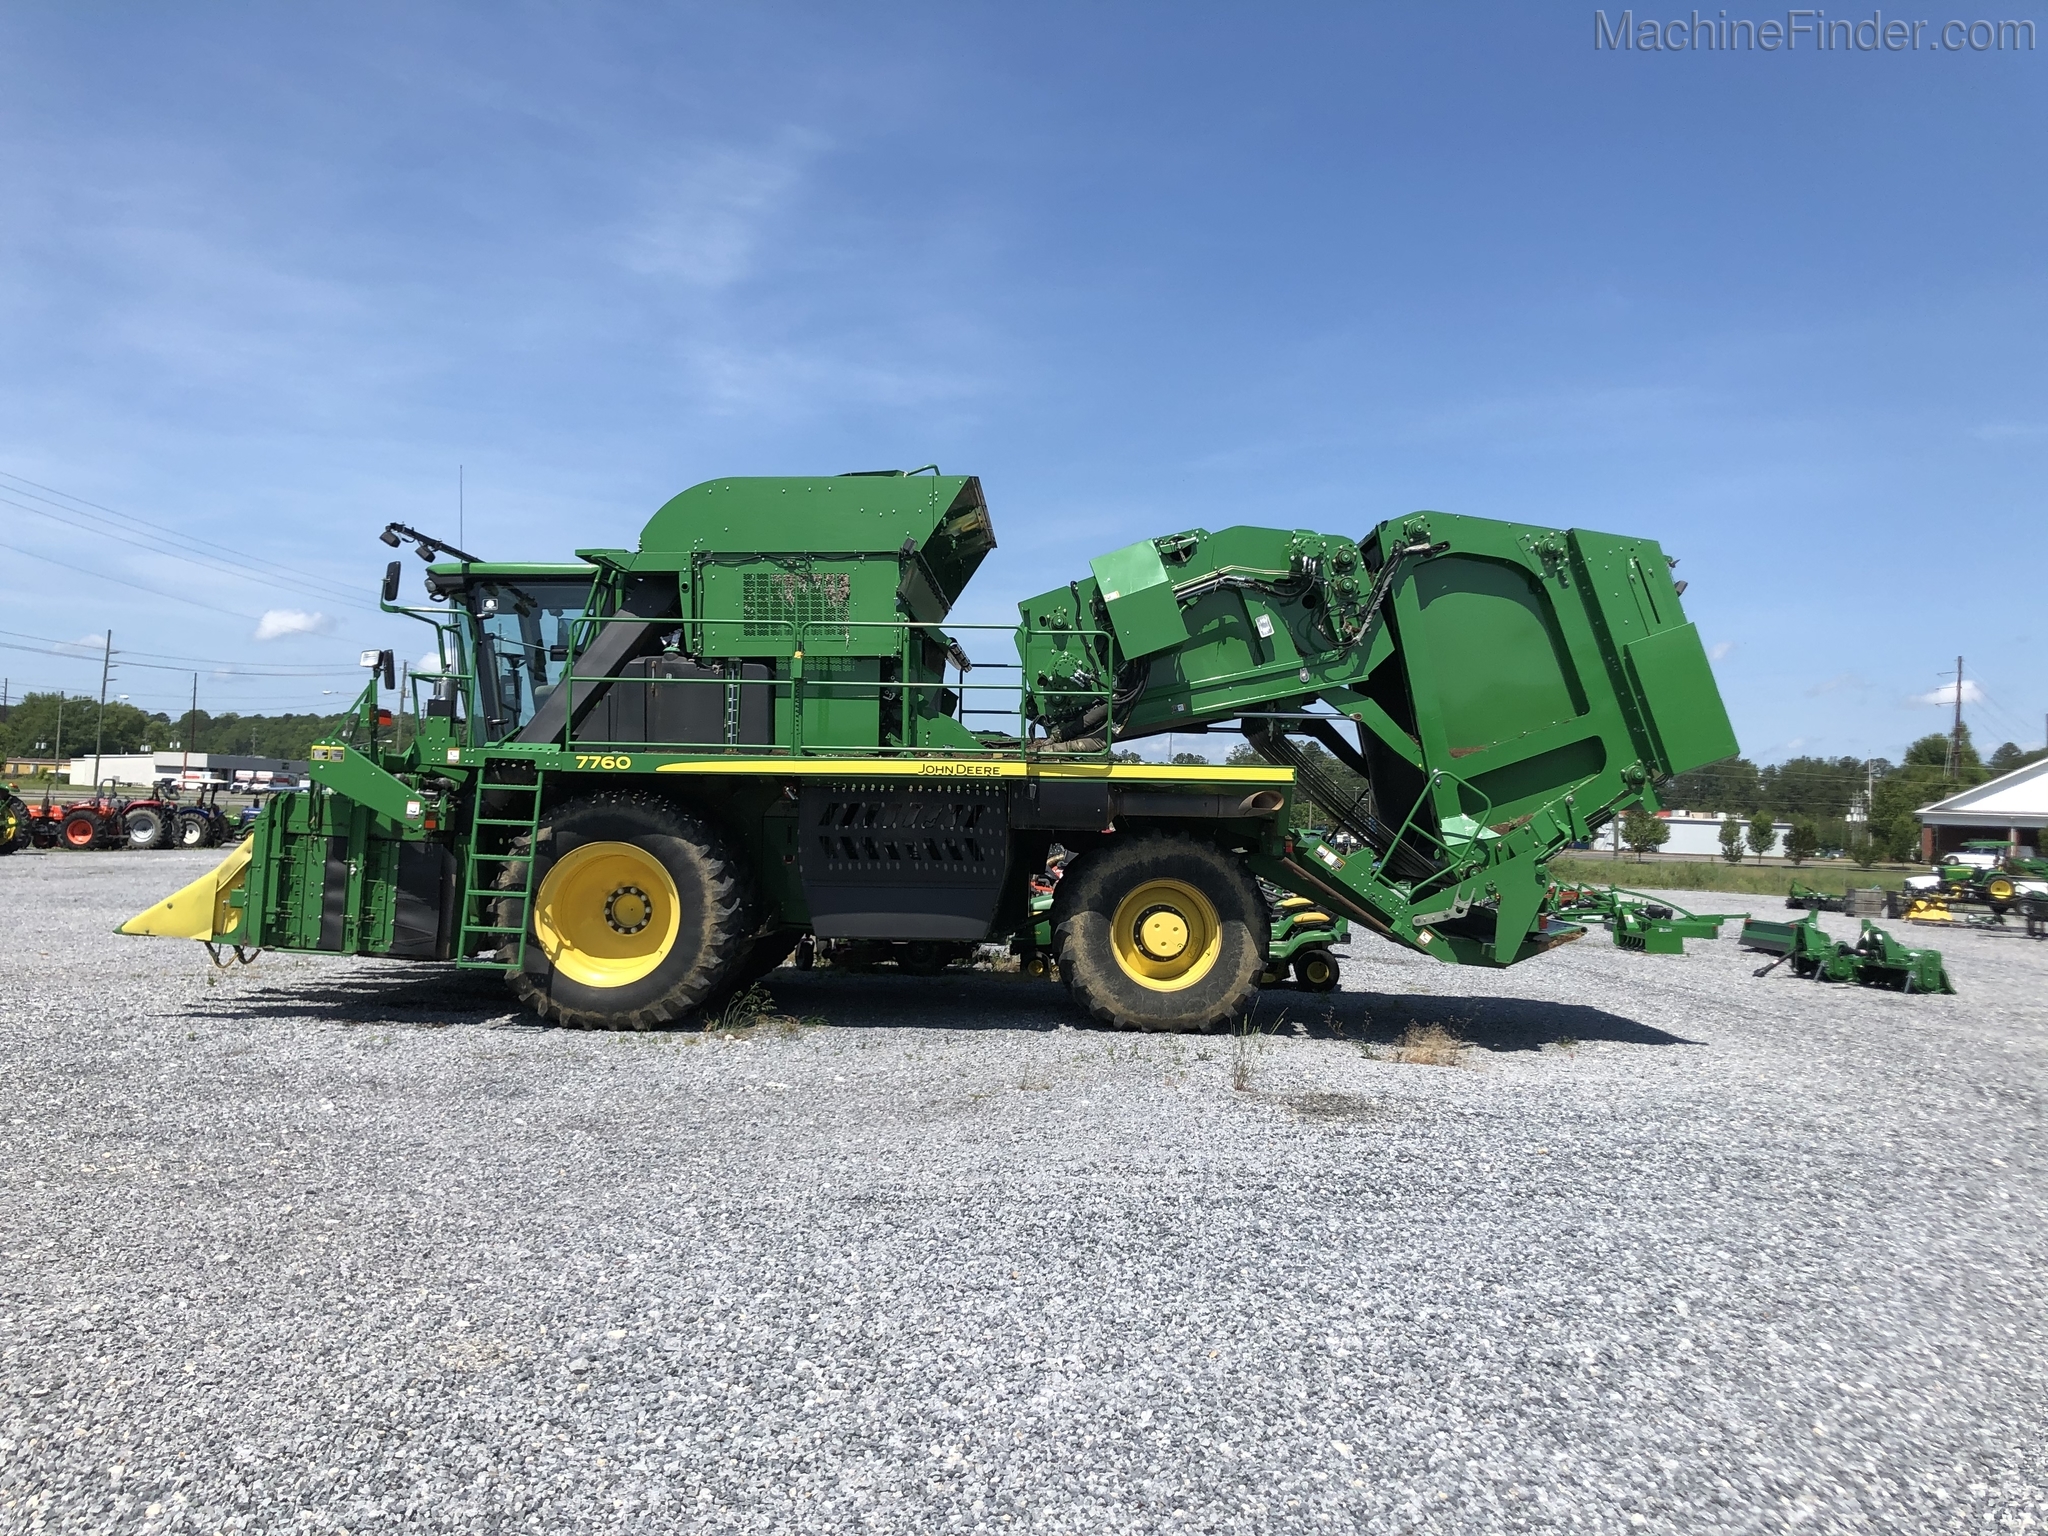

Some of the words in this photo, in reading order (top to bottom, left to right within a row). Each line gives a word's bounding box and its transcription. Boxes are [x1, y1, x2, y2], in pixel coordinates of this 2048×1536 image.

[575, 755, 632, 770] 7760
[918, 763, 954, 774] JOHN
[956, 764, 1001, 775] DEERE
